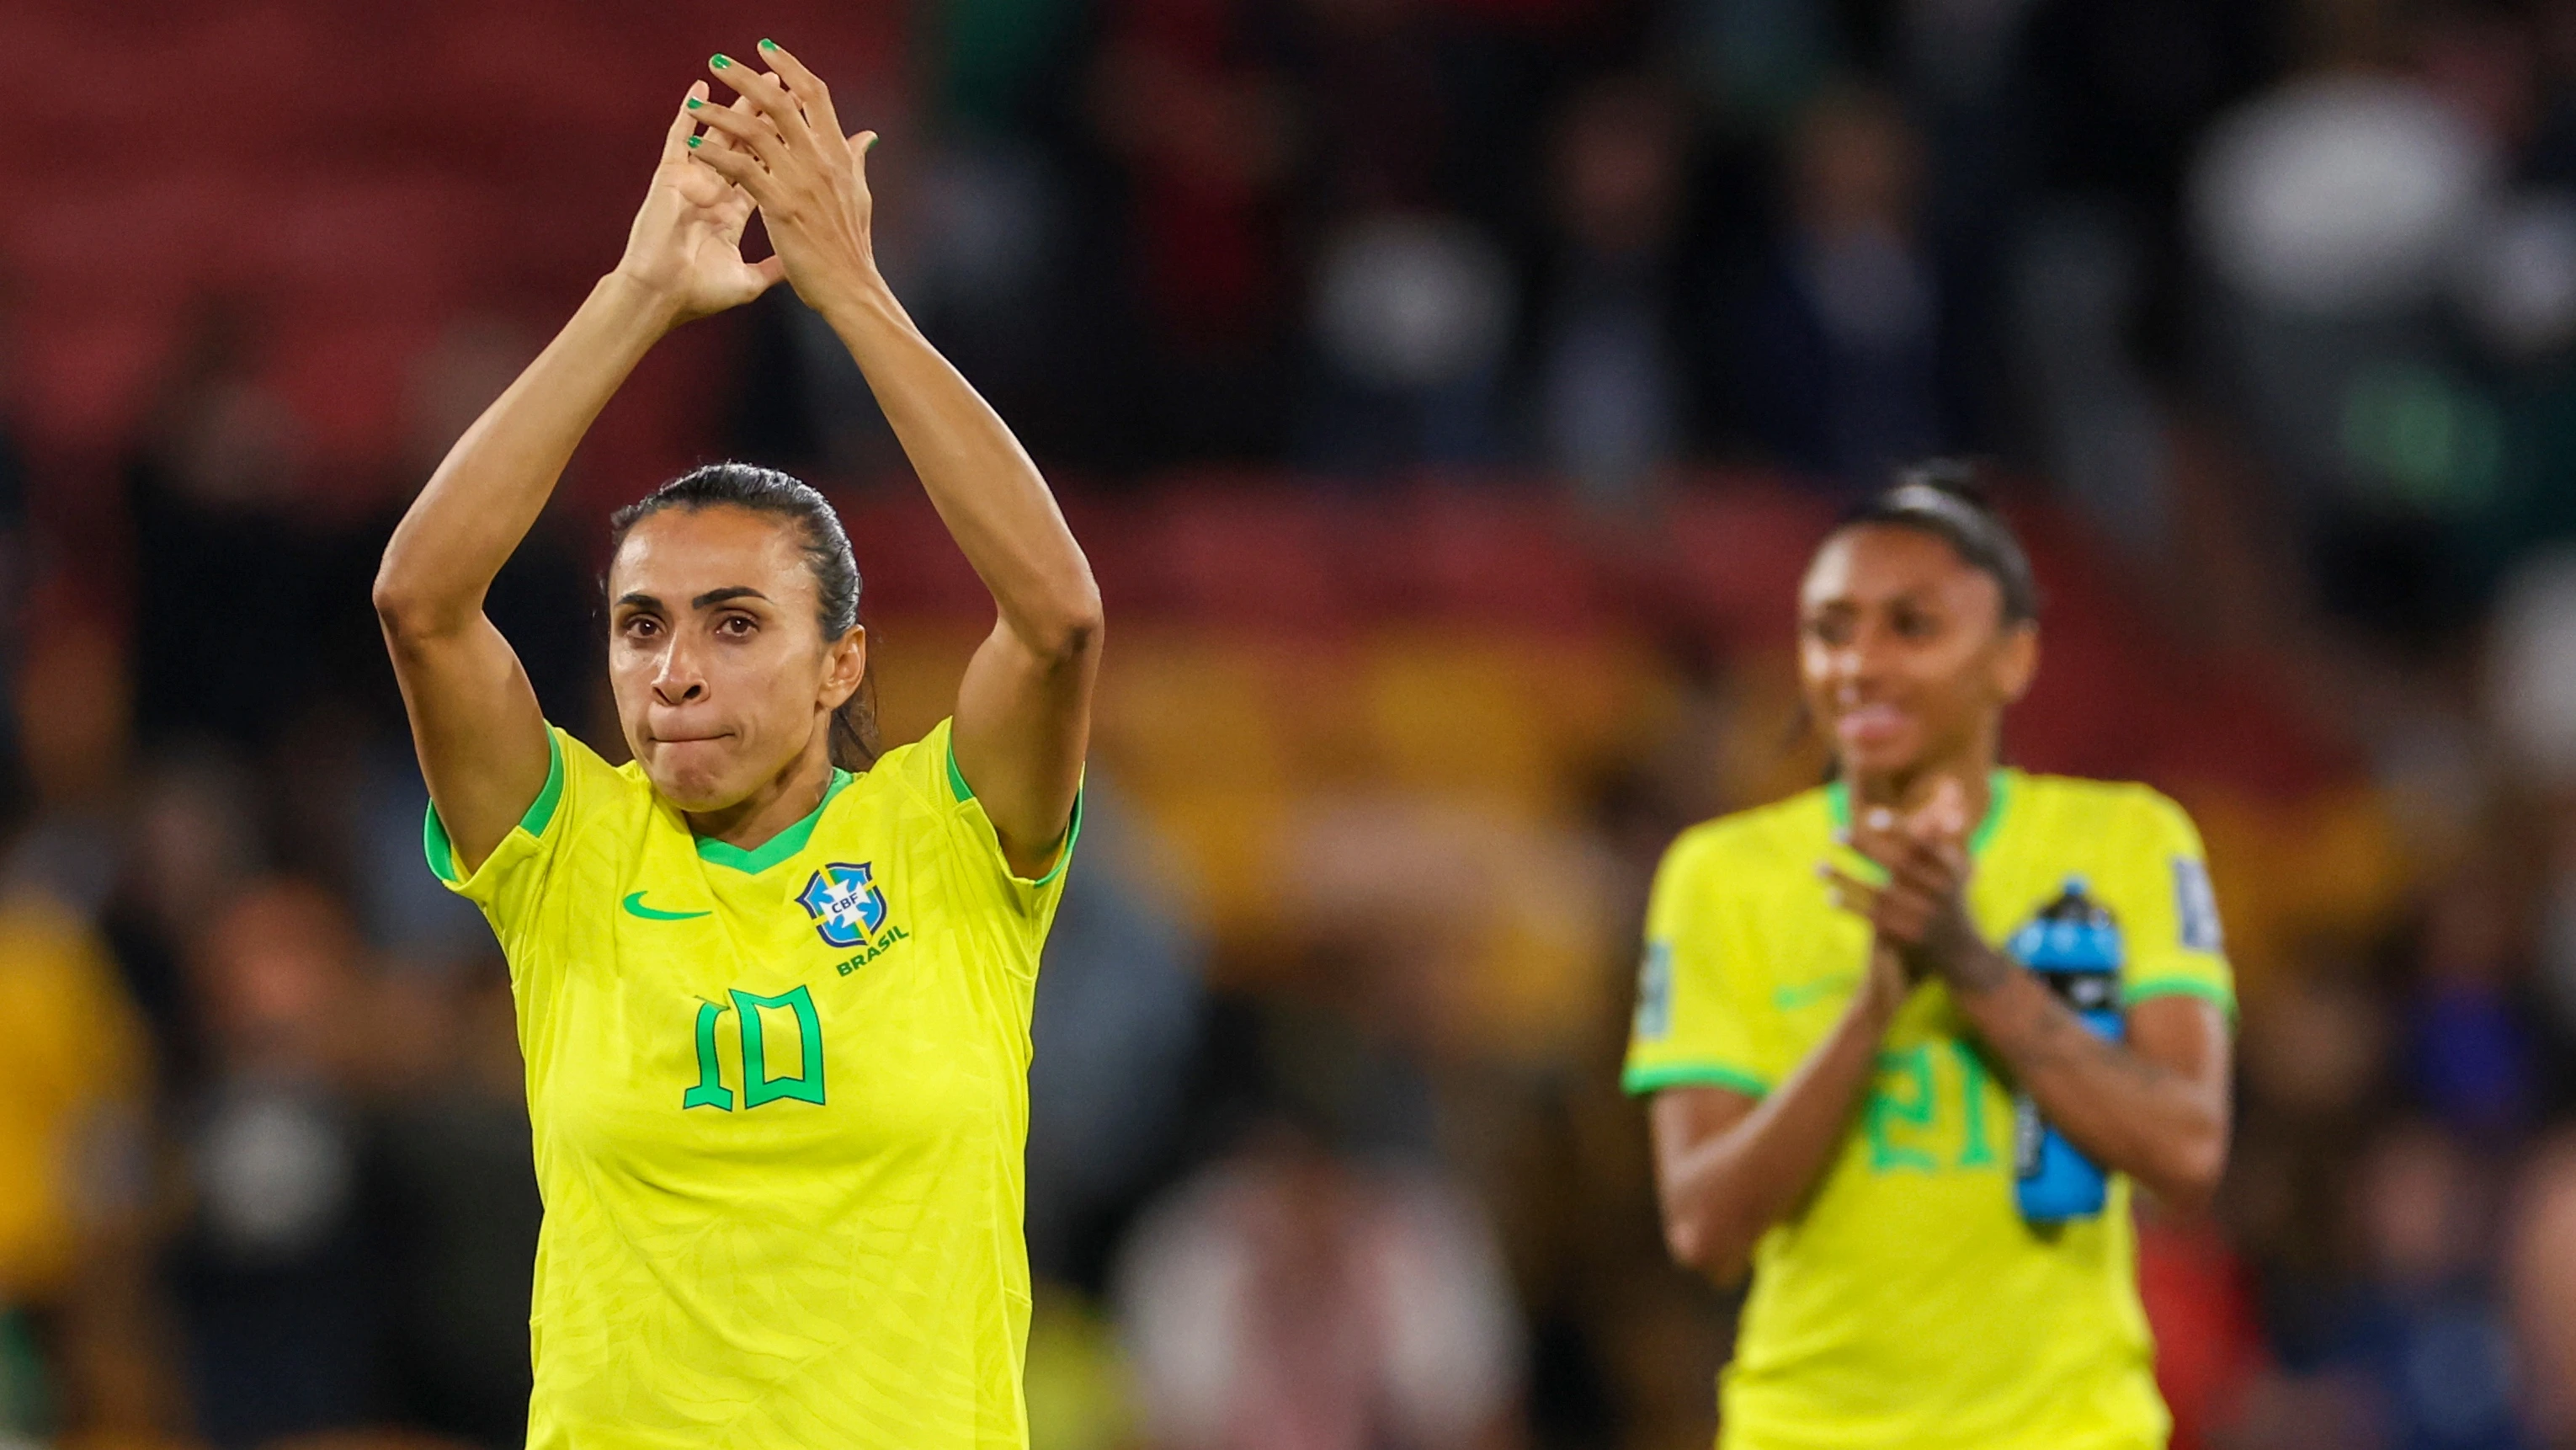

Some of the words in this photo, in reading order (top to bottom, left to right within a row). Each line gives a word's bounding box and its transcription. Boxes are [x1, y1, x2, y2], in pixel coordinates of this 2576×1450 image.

[831, 892, 859, 914] CBF
[836, 925, 909, 978] BRASIL
[683, 984, 826, 1111] 10
[1867, 1041, 1993, 1169] 21
